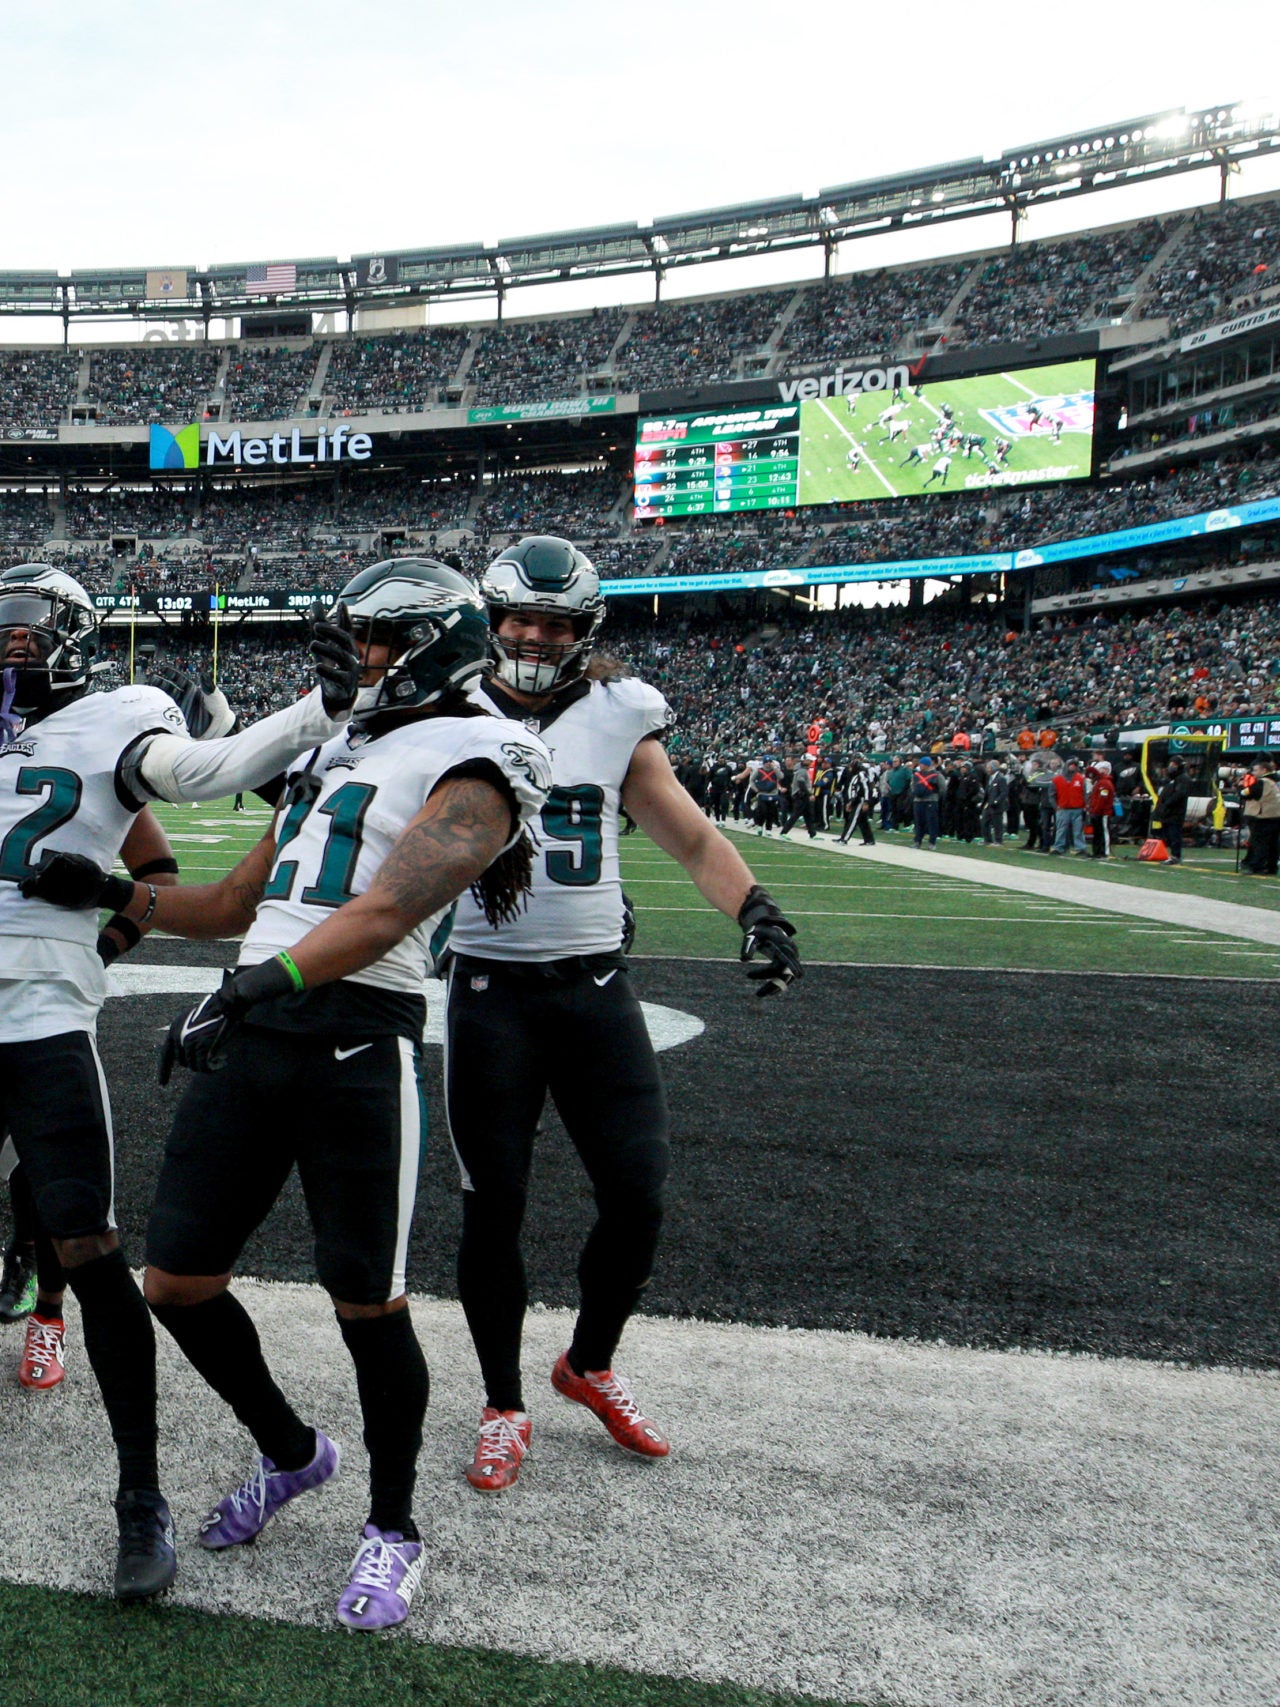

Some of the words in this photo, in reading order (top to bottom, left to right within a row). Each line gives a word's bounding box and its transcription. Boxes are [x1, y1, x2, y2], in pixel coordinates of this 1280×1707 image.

[1221, 313, 1267, 335] CURTIS
[778, 365, 910, 403] verizon
[503, 402, 548, 414] SUPER
[550, 400, 589, 411] BOWL
[520, 406, 590, 418] CHAMPIONS
[207, 424, 373, 465] MetLife
[965, 466, 1075, 487] ticketmaster
[96, 597, 115, 607] QTR
[119, 596, 140, 606] 4TH
[156, 597, 192, 609] 13:02
[227, 596, 270, 607] MetLife
[263, 781, 379, 908] 21
[32, 1367, 43, 1378] 3
[482, 1465, 494, 1476] 4
[201, 1513, 222, 1532] 2
[351, 1596, 368, 1615] 1
